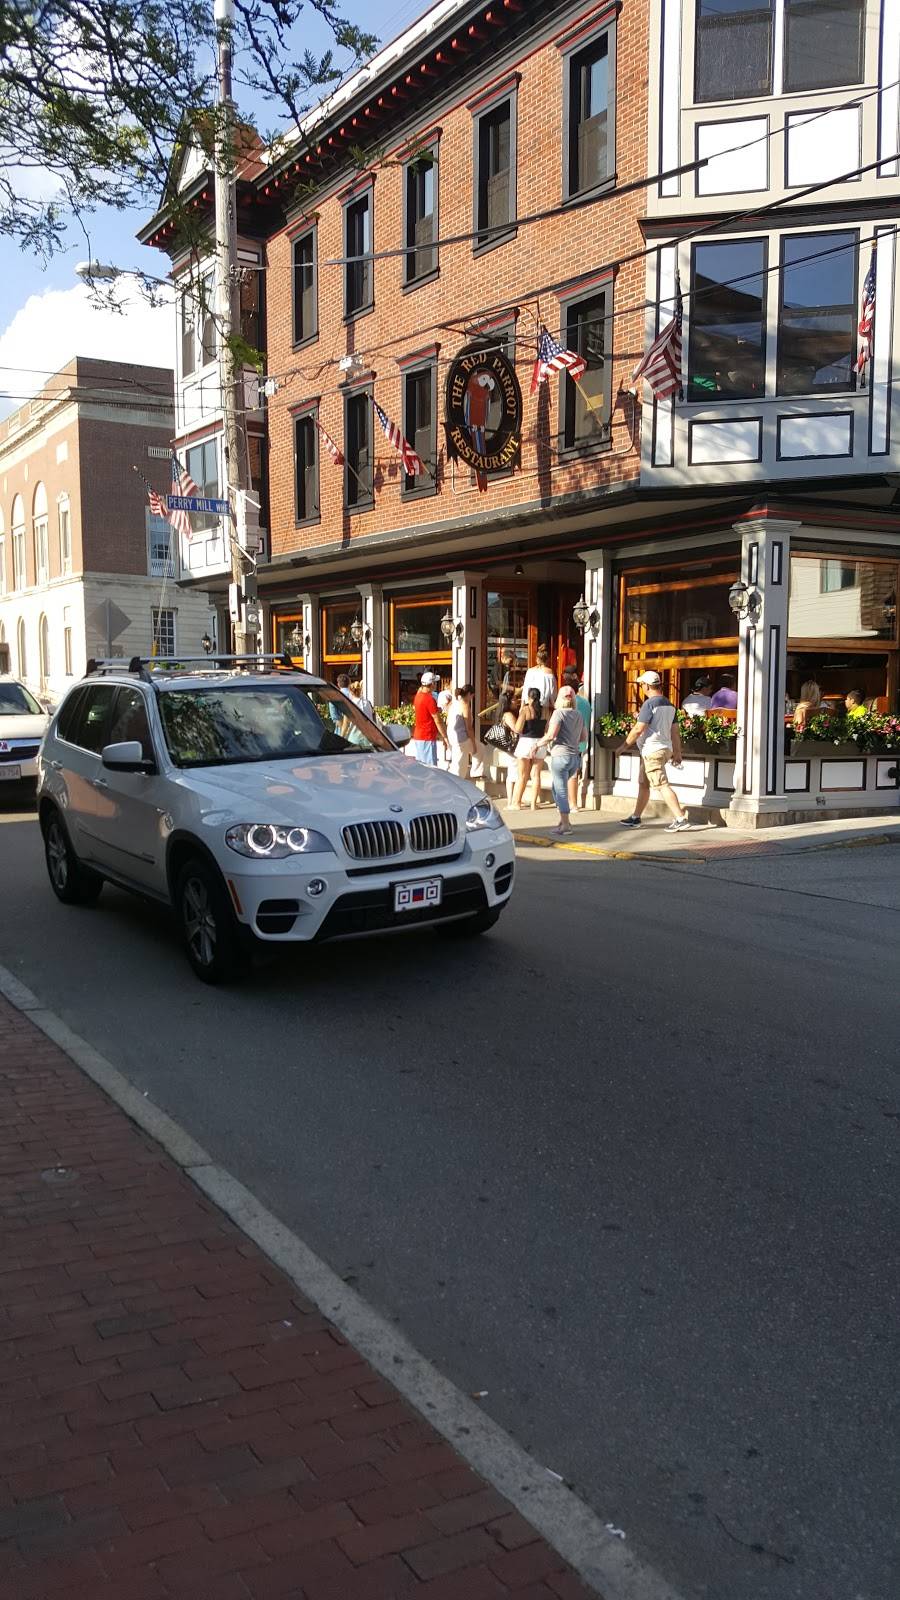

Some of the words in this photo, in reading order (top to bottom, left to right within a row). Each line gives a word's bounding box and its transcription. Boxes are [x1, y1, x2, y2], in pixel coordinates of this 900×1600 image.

[452, 375, 465, 408] THE
[461, 353, 487, 372] RED
[492, 356, 517, 418] PARROT
[451, 427, 518, 469] RESTAURANT
[168, 496, 192, 509] PERRY
[196, 499, 213, 511] MILL
